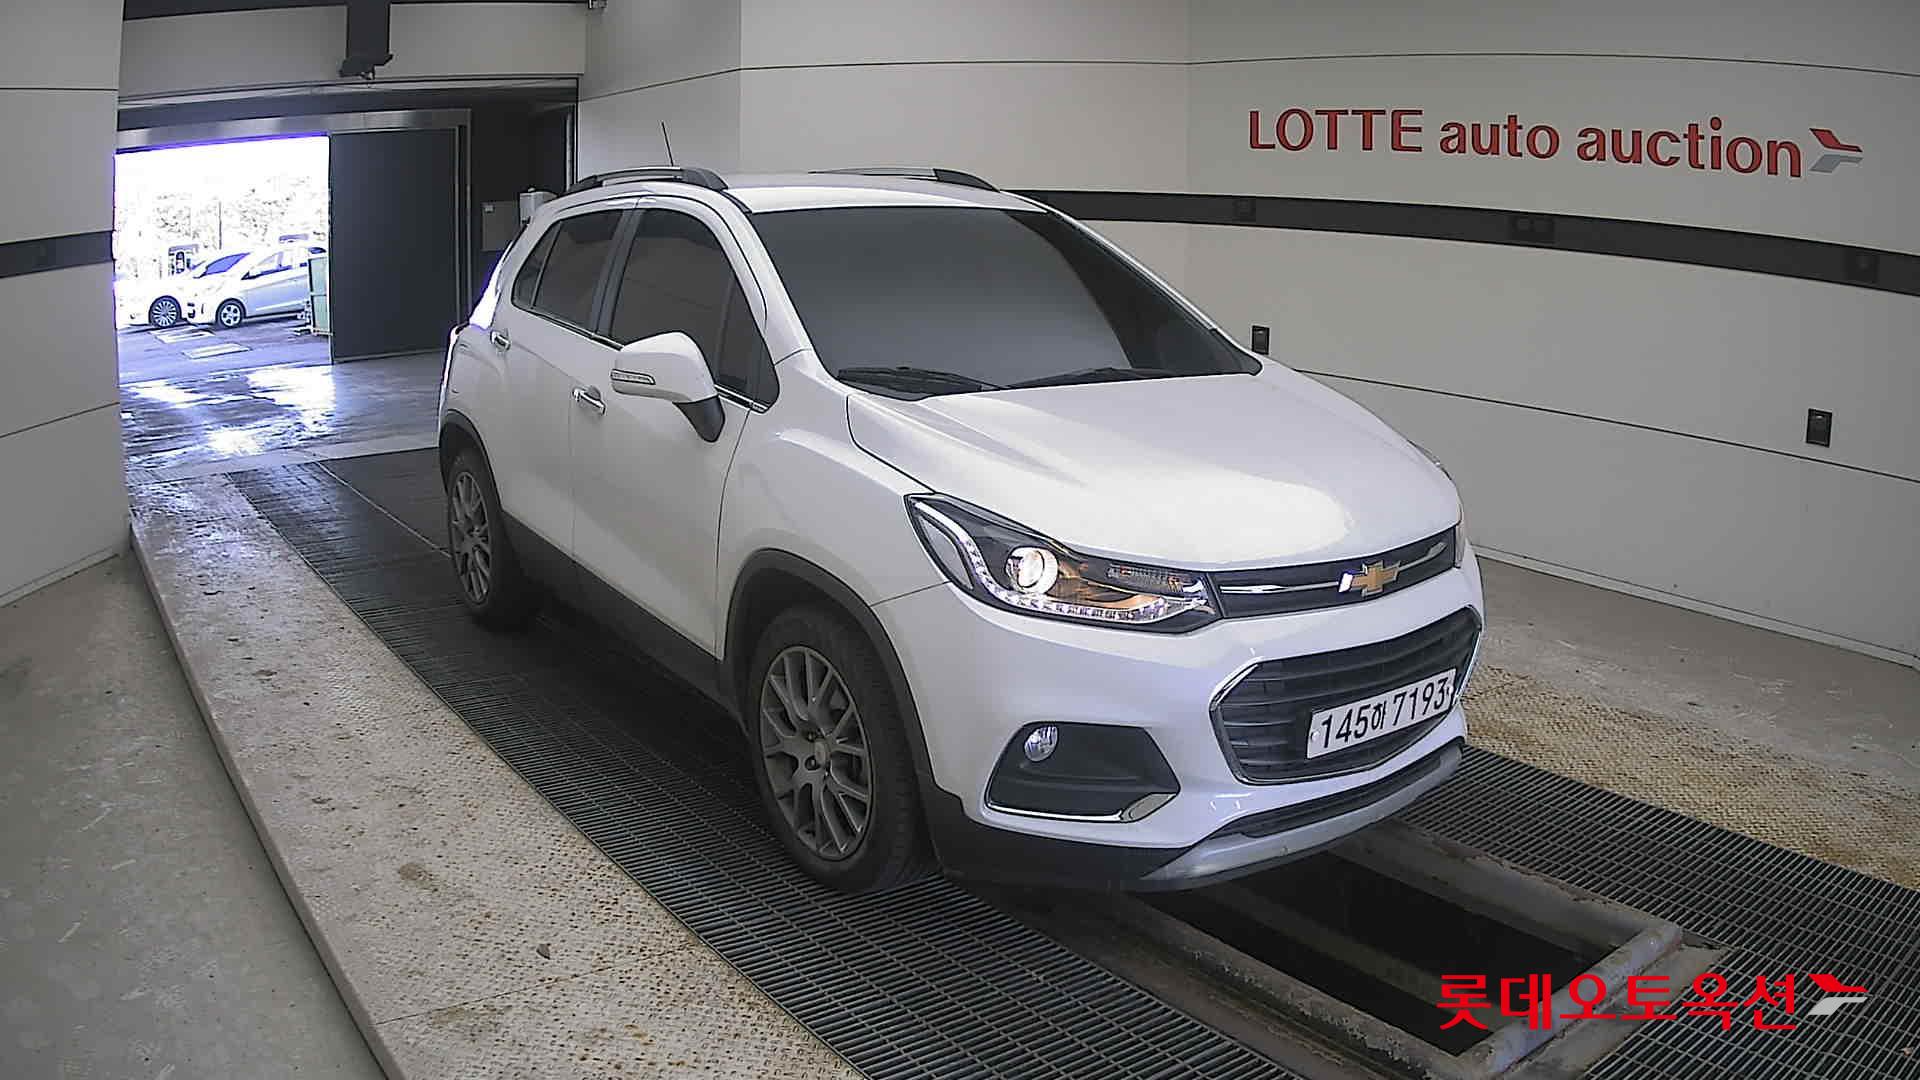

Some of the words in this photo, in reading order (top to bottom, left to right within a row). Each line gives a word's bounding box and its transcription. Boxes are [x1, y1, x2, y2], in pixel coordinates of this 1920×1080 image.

[1248, 109, 1424, 153] LOTTE
[1439, 114, 1561, 160] auto
[1576, 116, 1802, 178] auction
[1321, 701, 1387, 749] 145하
[1392, 677, 1449, 727] 7193
